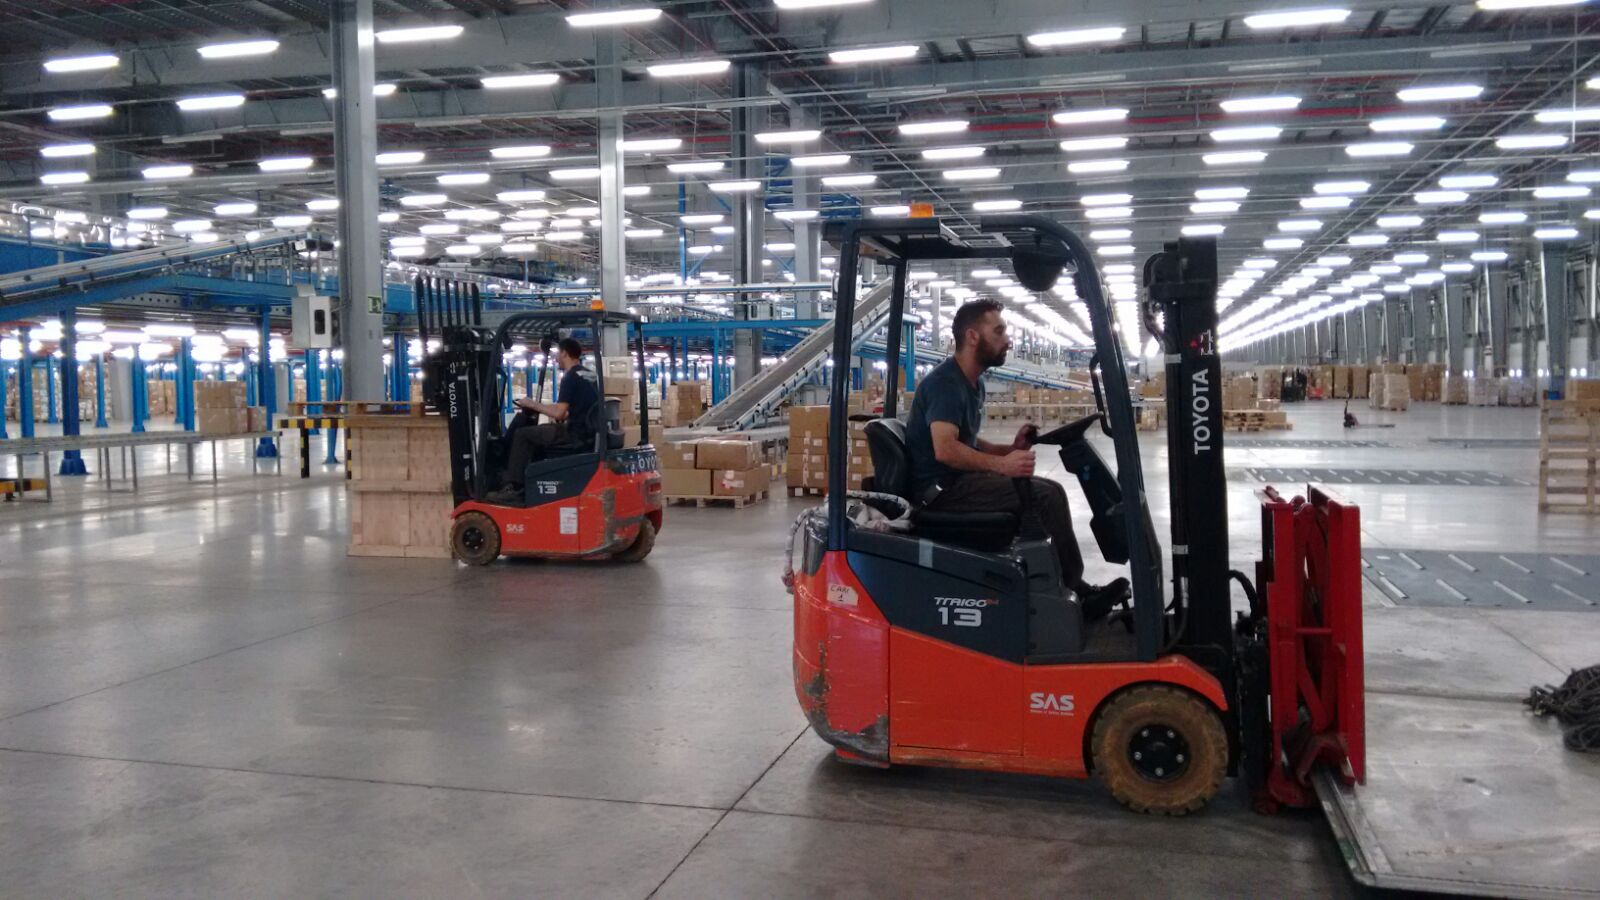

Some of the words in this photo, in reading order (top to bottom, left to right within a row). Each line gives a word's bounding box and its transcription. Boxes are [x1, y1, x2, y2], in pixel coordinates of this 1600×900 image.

[449, 382, 457, 419] TOYOTA
[1192, 368, 1211, 455] TOYOTA
[538, 485, 557, 494] 13
[938, 607, 982, 627] 13
[1030, 692, 1074, 711] SAS
